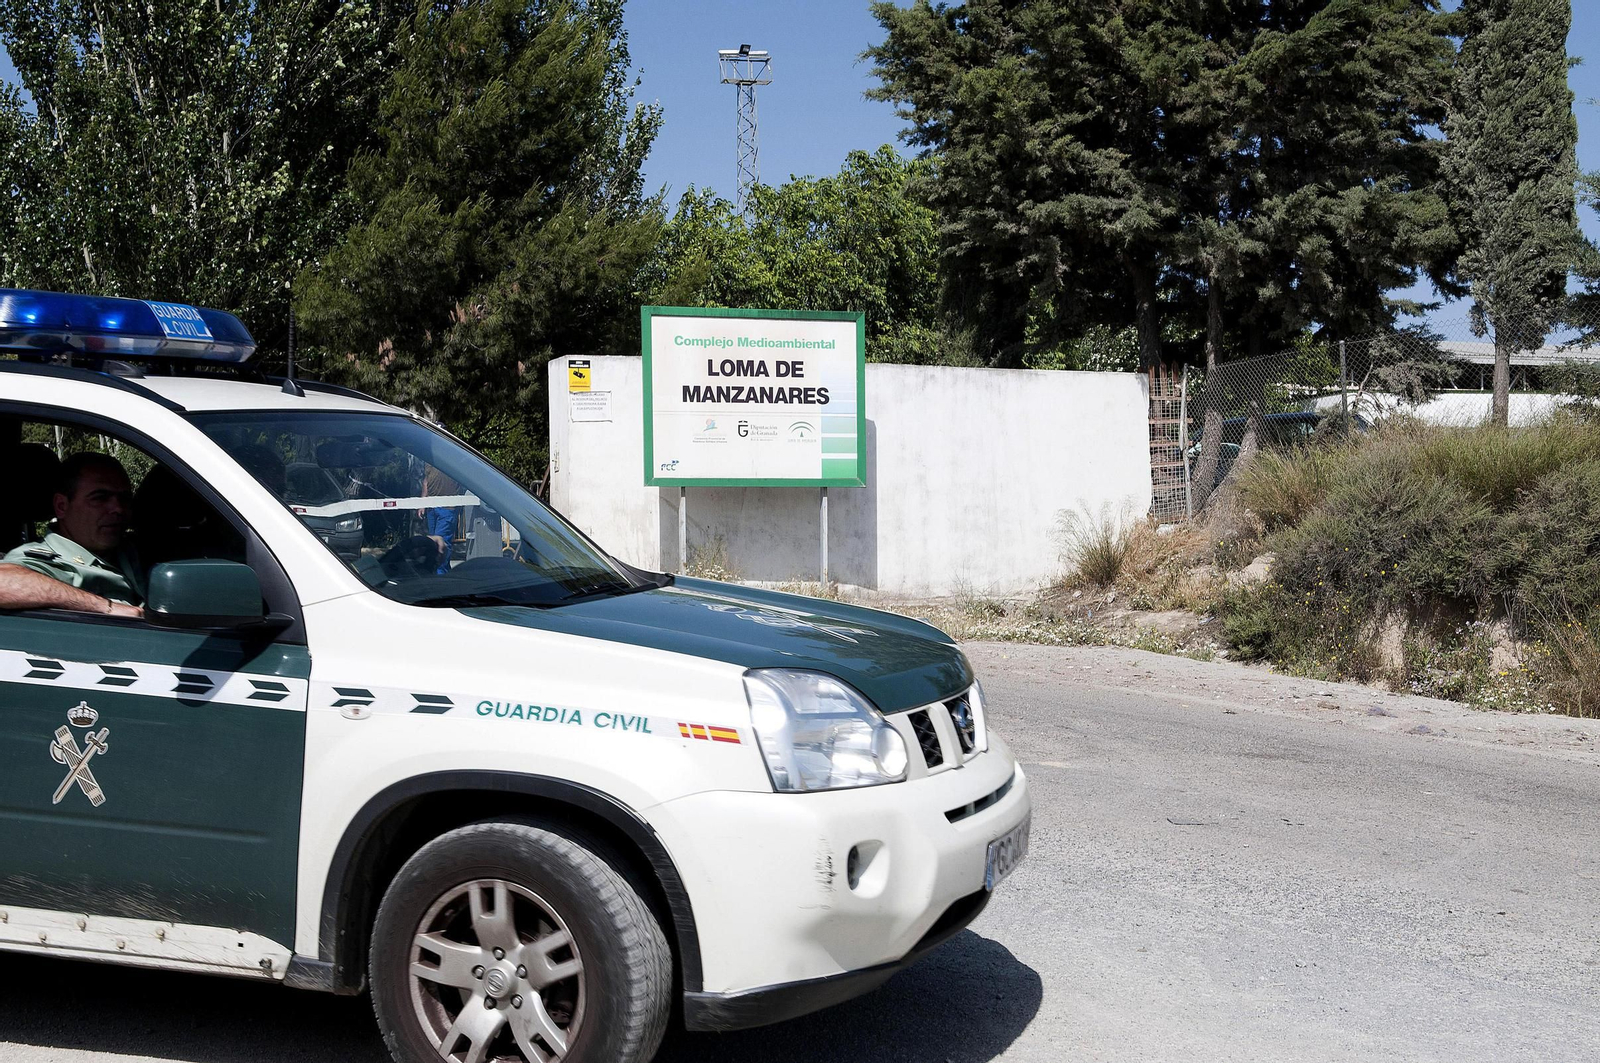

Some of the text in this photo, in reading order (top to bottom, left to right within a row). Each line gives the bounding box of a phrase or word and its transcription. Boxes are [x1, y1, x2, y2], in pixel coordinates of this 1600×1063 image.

[151, 304, 204, 321] GUARDIA
[172, 320, 206, 336] CIVIL
[674, 335, 836, 350] Complejo Medioambiental
[707, 359, 804, 378] LOMA DE
[682, 385, 830, 405] MANZANARES
[476, 700, 652, 734] GUARDIA CIVIL
